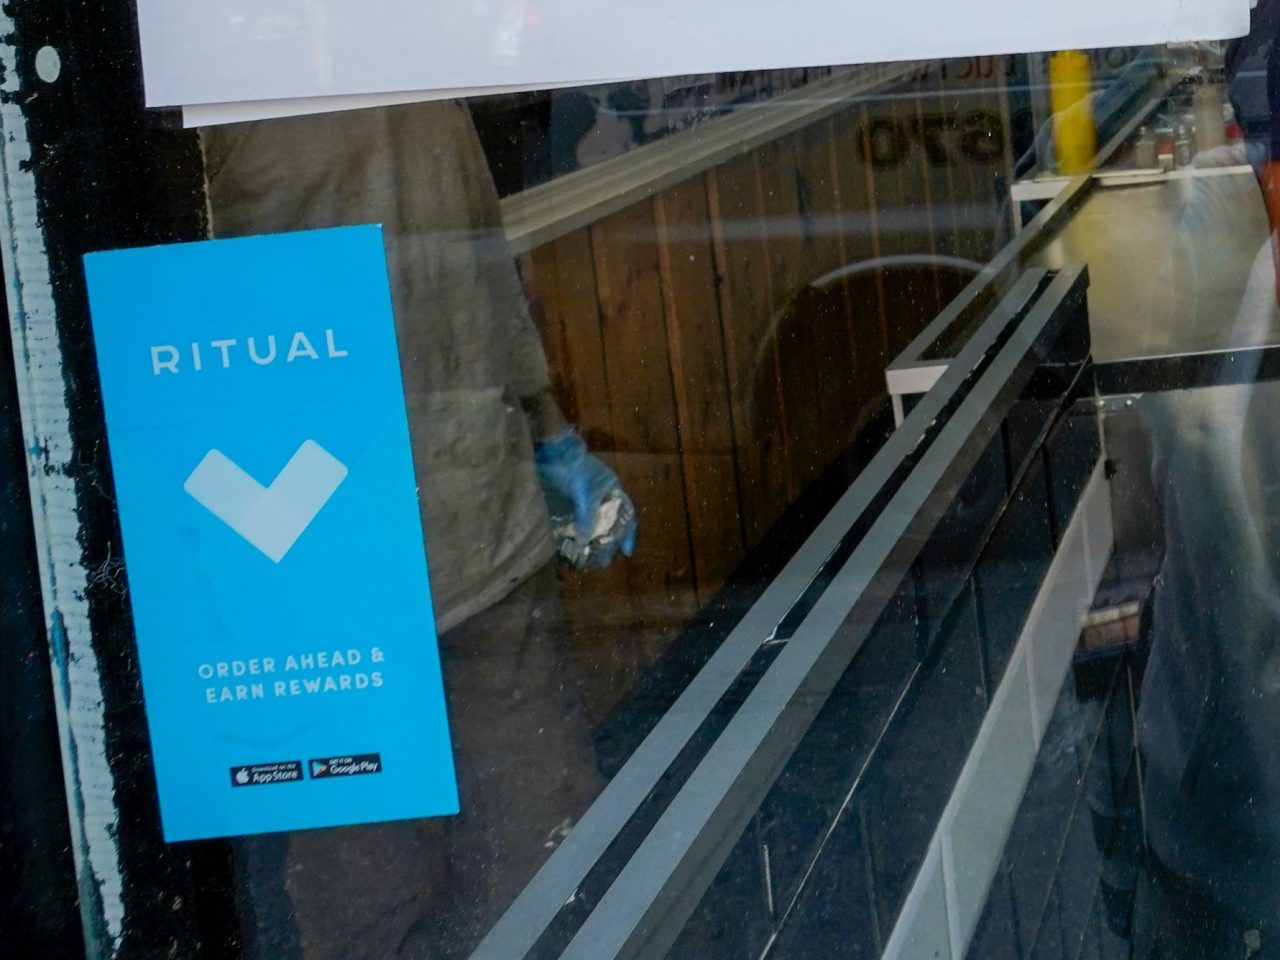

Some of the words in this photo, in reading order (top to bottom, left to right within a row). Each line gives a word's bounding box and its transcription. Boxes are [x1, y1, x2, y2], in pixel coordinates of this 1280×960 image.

[150, 328, 349, 376] RITUAL
[198, 657, 276, 680] ORDER
[285, 649, 361, 672] AHEAD
[371, 647, 385, 663] &
[206, 683, 265, 704] EARN
[274, 672, 384, 697] REWARDS
[252, 772, 273, 784] App
[273, 769, 299, 781] Store
[329, 763, 360, 775] Google
[359, 761, 379, 773] Play
